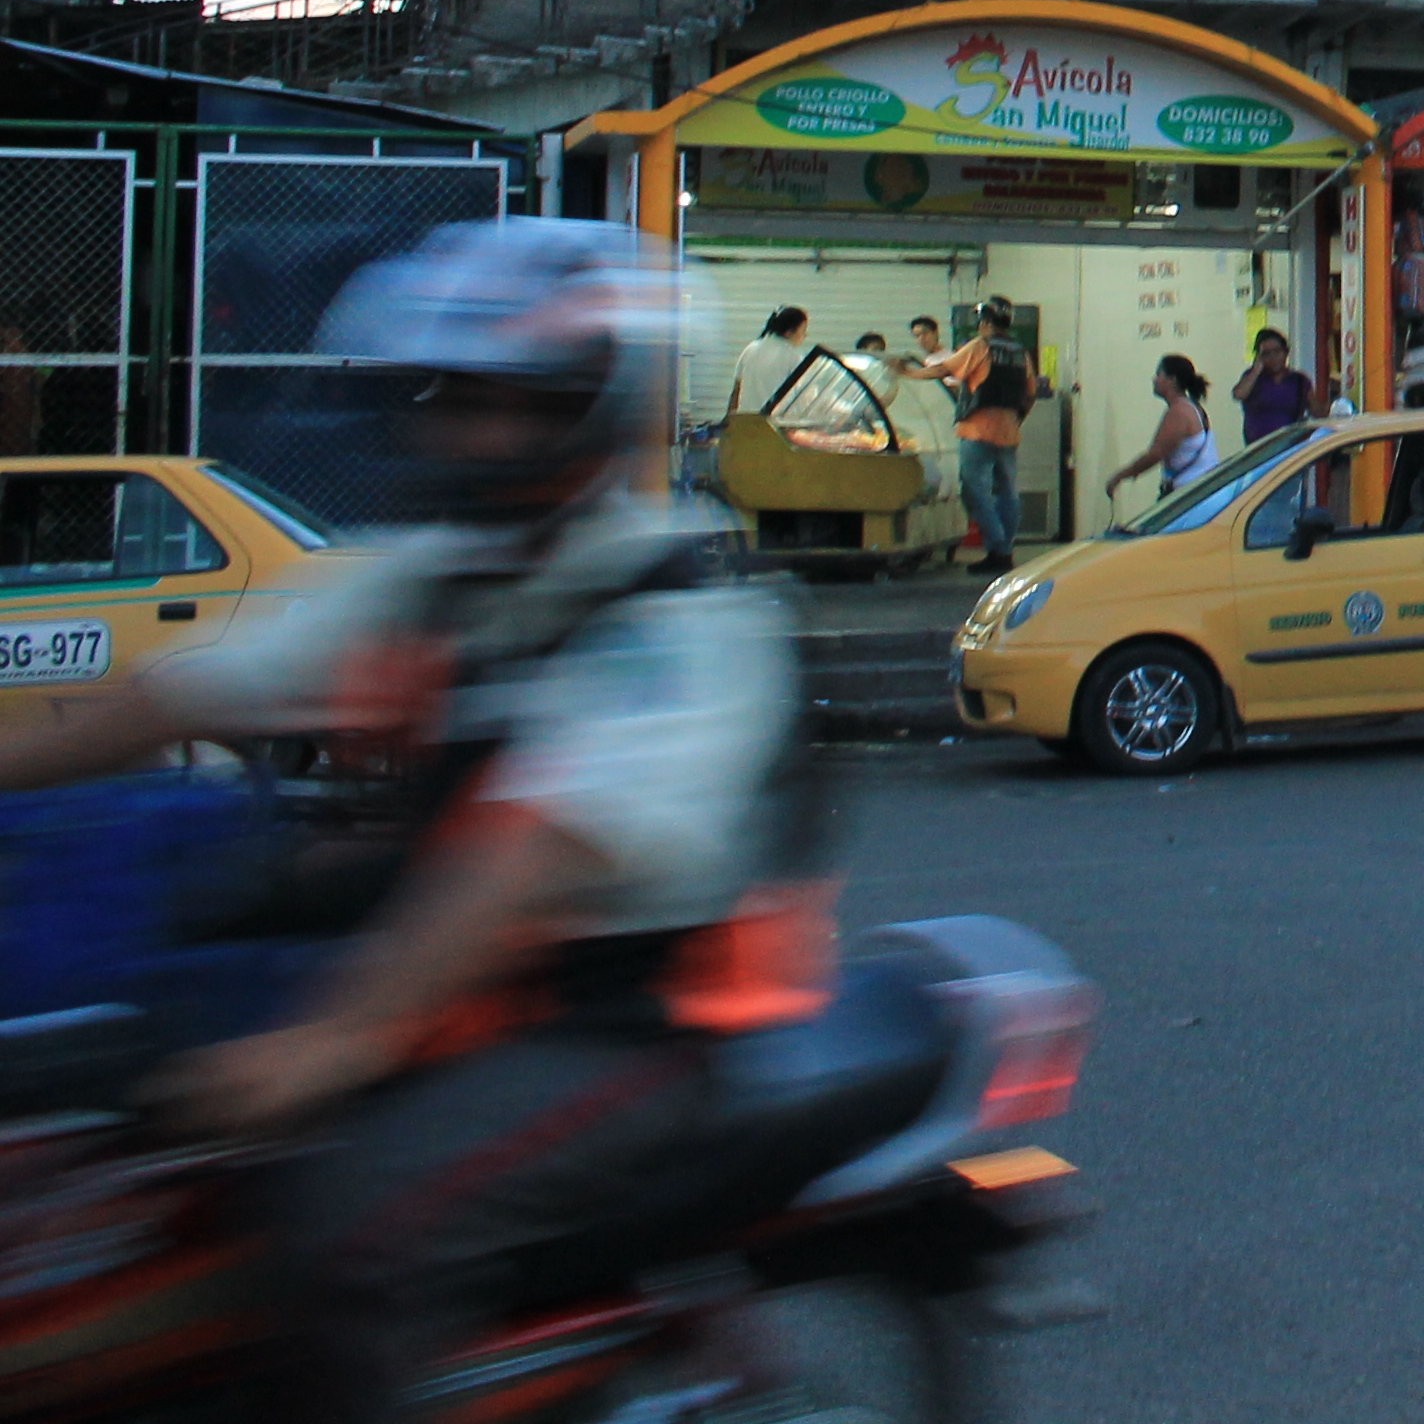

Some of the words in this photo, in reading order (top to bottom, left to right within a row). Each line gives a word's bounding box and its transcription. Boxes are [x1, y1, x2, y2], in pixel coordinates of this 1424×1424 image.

[1012, 48, 1133, 98] Avícola
[776, 85, 824, 101] POLLO
[828, 87, 892, 104] CRIOLLO
[798, 102, 854, 117] ENTERO
[787, 116, 819, 131] POR
[1036, 100, 1128, 147] Miguel
[1183, 126, 1217, 144] 832
[1221, 127, 1243, 145] 38
[1249, 128, 1270, 146] 90
[1345, 194, 1357, 390] HUEVOS
